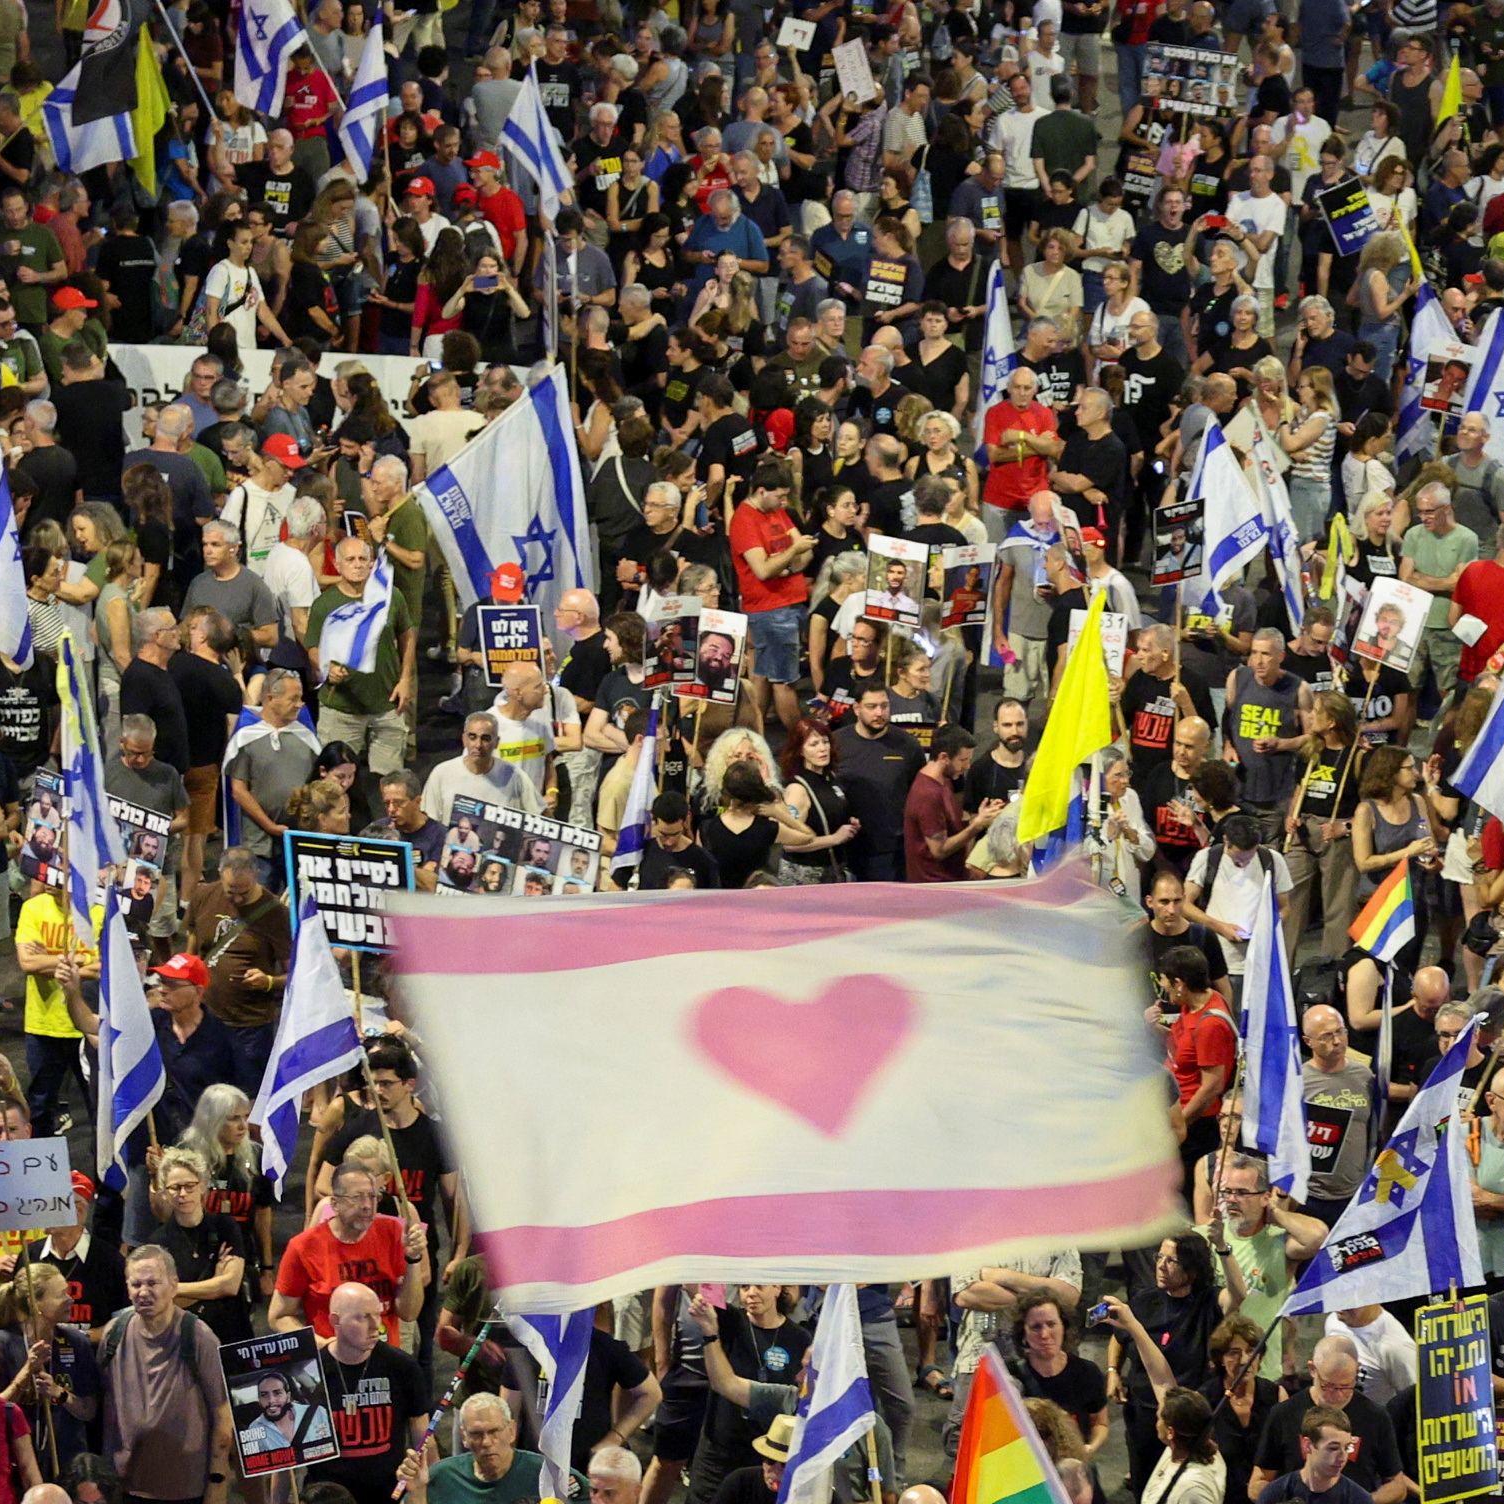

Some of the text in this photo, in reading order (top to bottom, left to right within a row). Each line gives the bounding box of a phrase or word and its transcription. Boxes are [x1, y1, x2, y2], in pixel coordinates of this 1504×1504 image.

[1241, 704, 1282, 726] SEAL
[298, 853, 400, 887] לסיים את
[240, 1426, 267, 1443] BRING
[241, 1441, 260, 1456] HIM
